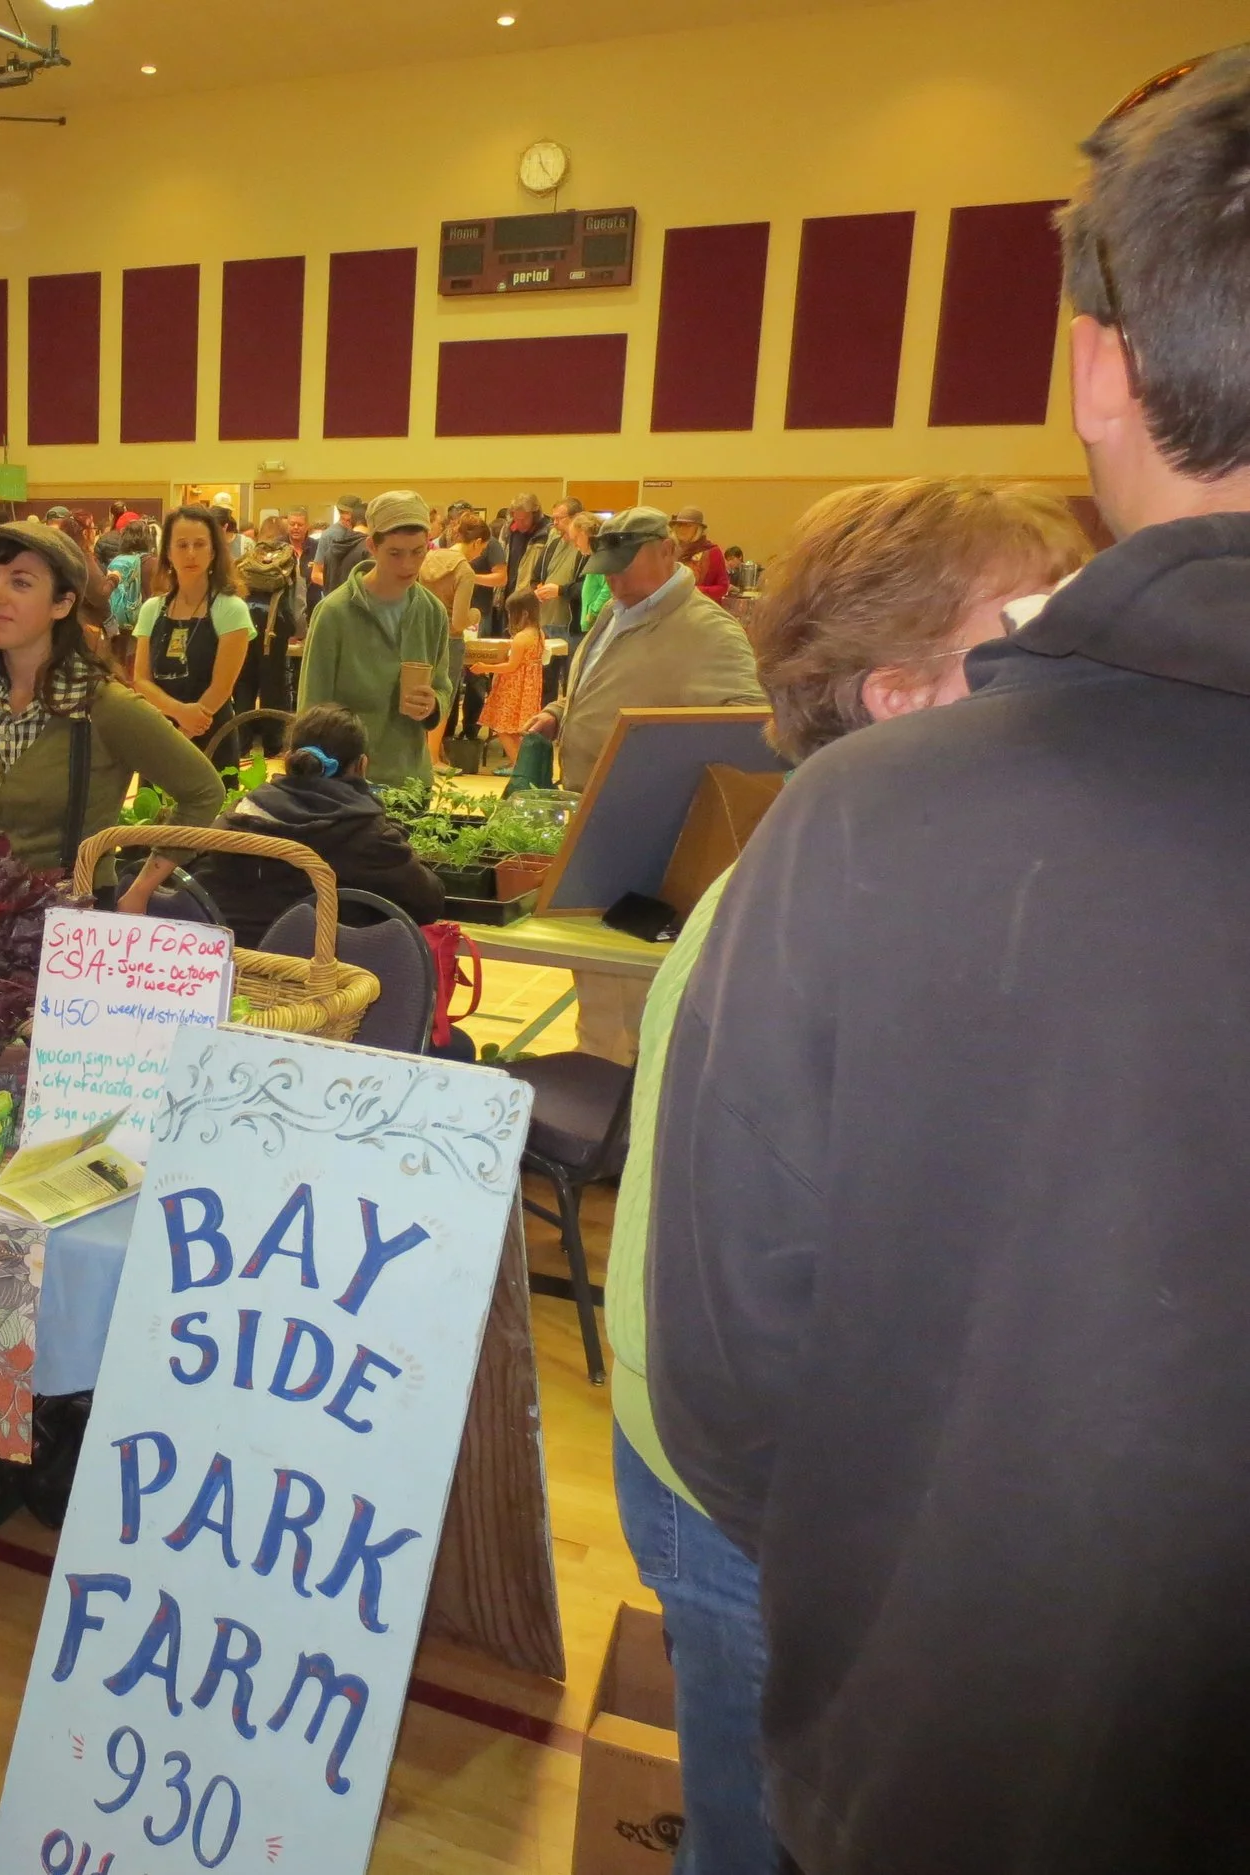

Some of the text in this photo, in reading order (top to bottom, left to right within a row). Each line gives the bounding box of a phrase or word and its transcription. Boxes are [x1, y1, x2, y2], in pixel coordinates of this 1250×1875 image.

[512, 268, 550, 287] period
[48, 922, 98, 958] Sign
[108, 927, 142, 958] up
[117, 958, 156, 975] June
[40, 994, 100, 1029] $450
[116, 1053, 136, 1077] up
[157, 1182, 432, 1317] BAY
[168, 1308, 403, 1434] SIDE
[110, 1430, 423, 1634] PARK
[51, 1572, 370, 1796] FARM
[93, 1724, 242, 1869] 930
